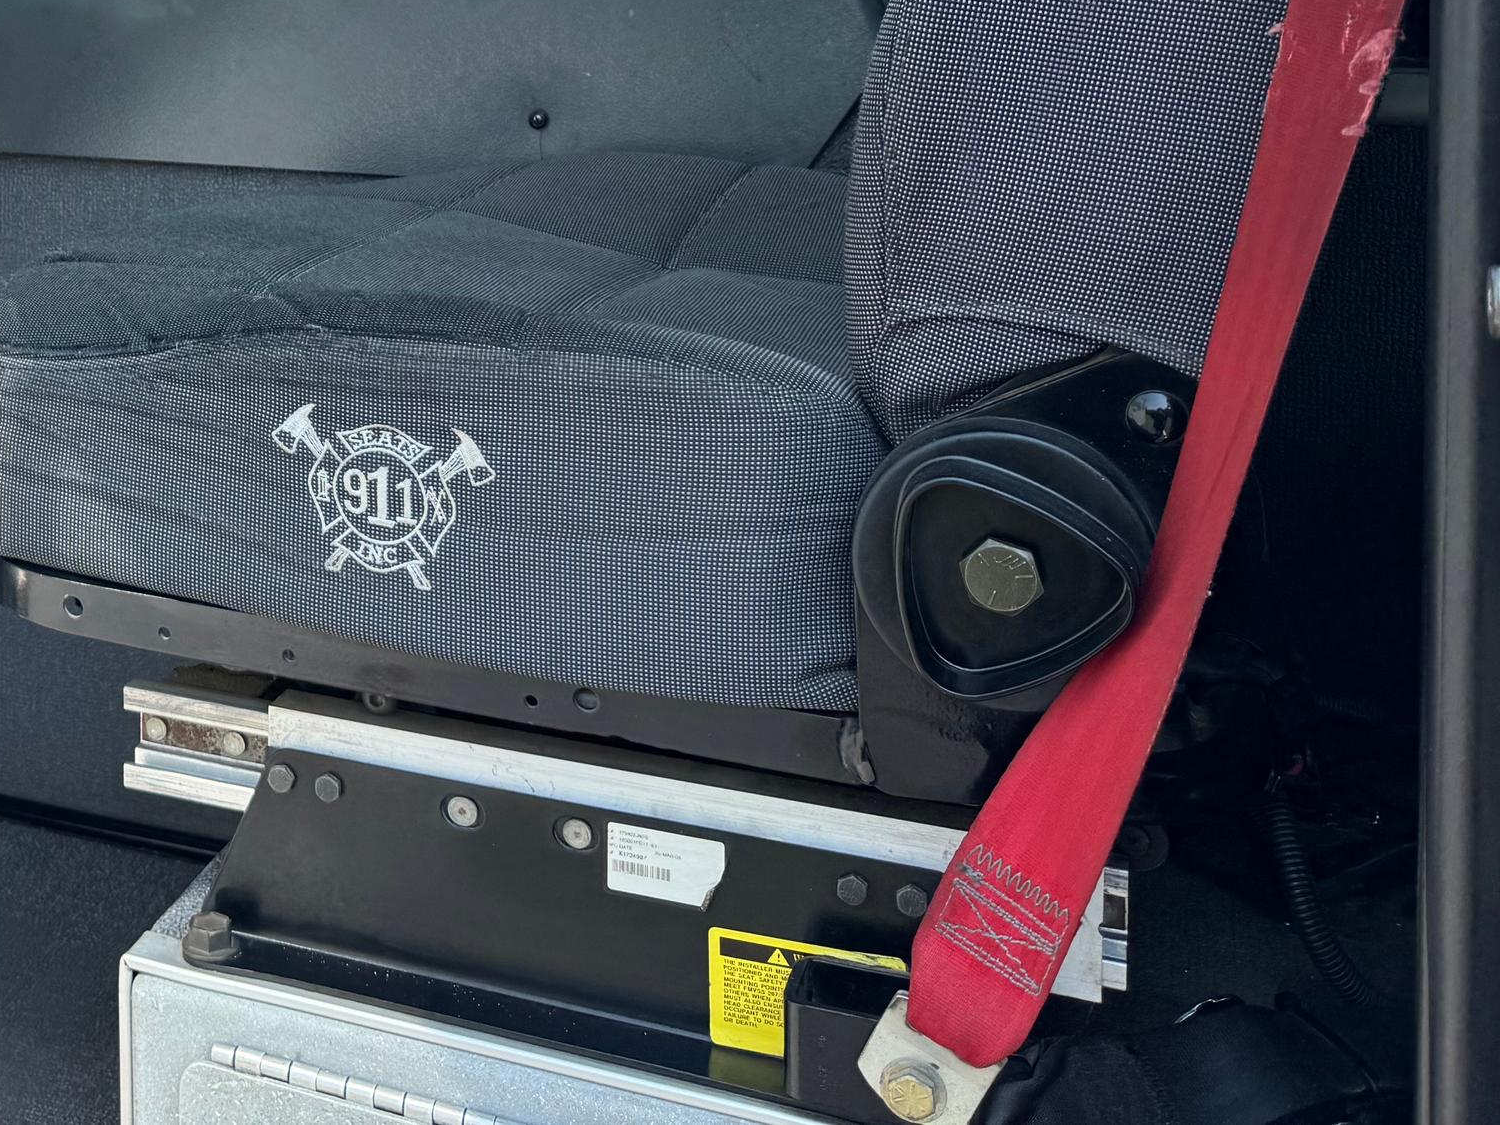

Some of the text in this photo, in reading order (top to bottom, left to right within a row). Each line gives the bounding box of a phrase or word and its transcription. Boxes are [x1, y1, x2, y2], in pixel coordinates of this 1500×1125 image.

[350, 429, 419, 458] SEATS
[342, 465, 418, 529] 911
[358, 541, 398, 565] INC
[723, 964, 763, 976] POSITIONED
[738, 961, 773, 973] INSTALLER
[775, 968, 790, 976] MUS
[723, 976, 759, 987] MOUNTING
[759, 977, 783, 986] SAFETY
[723, 987, 750, 998] OTHERS
[751, 993, 771, 1002] WHEN
[723, 993, 741, 1001] MUST
[723, 999, 741, 1007] HEAD
[723, 1005, 759, 1016] OCCUPANT
[723, 1011, 750, 1021] FAILURE
